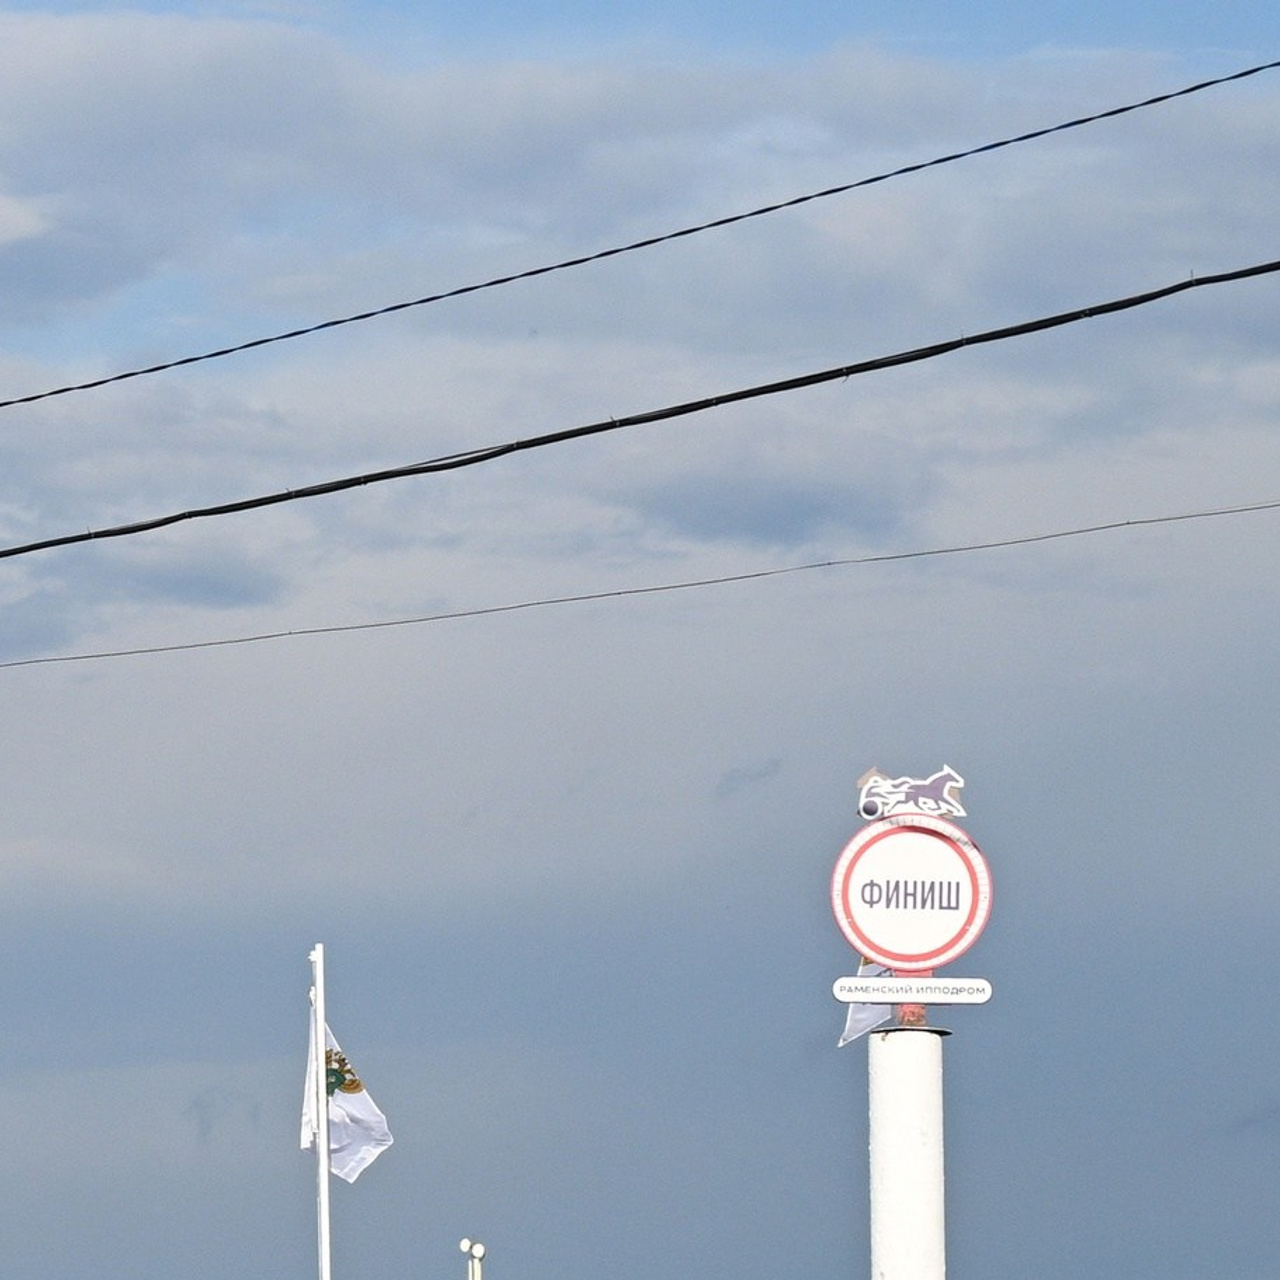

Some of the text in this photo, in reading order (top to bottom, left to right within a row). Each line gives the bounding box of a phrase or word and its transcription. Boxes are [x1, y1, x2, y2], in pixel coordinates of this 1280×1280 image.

[860, 879, 961, 911] ФИНИШ
[839, 984, 986, 996] РАМЕНСКИЙ ИППОДРОМ
